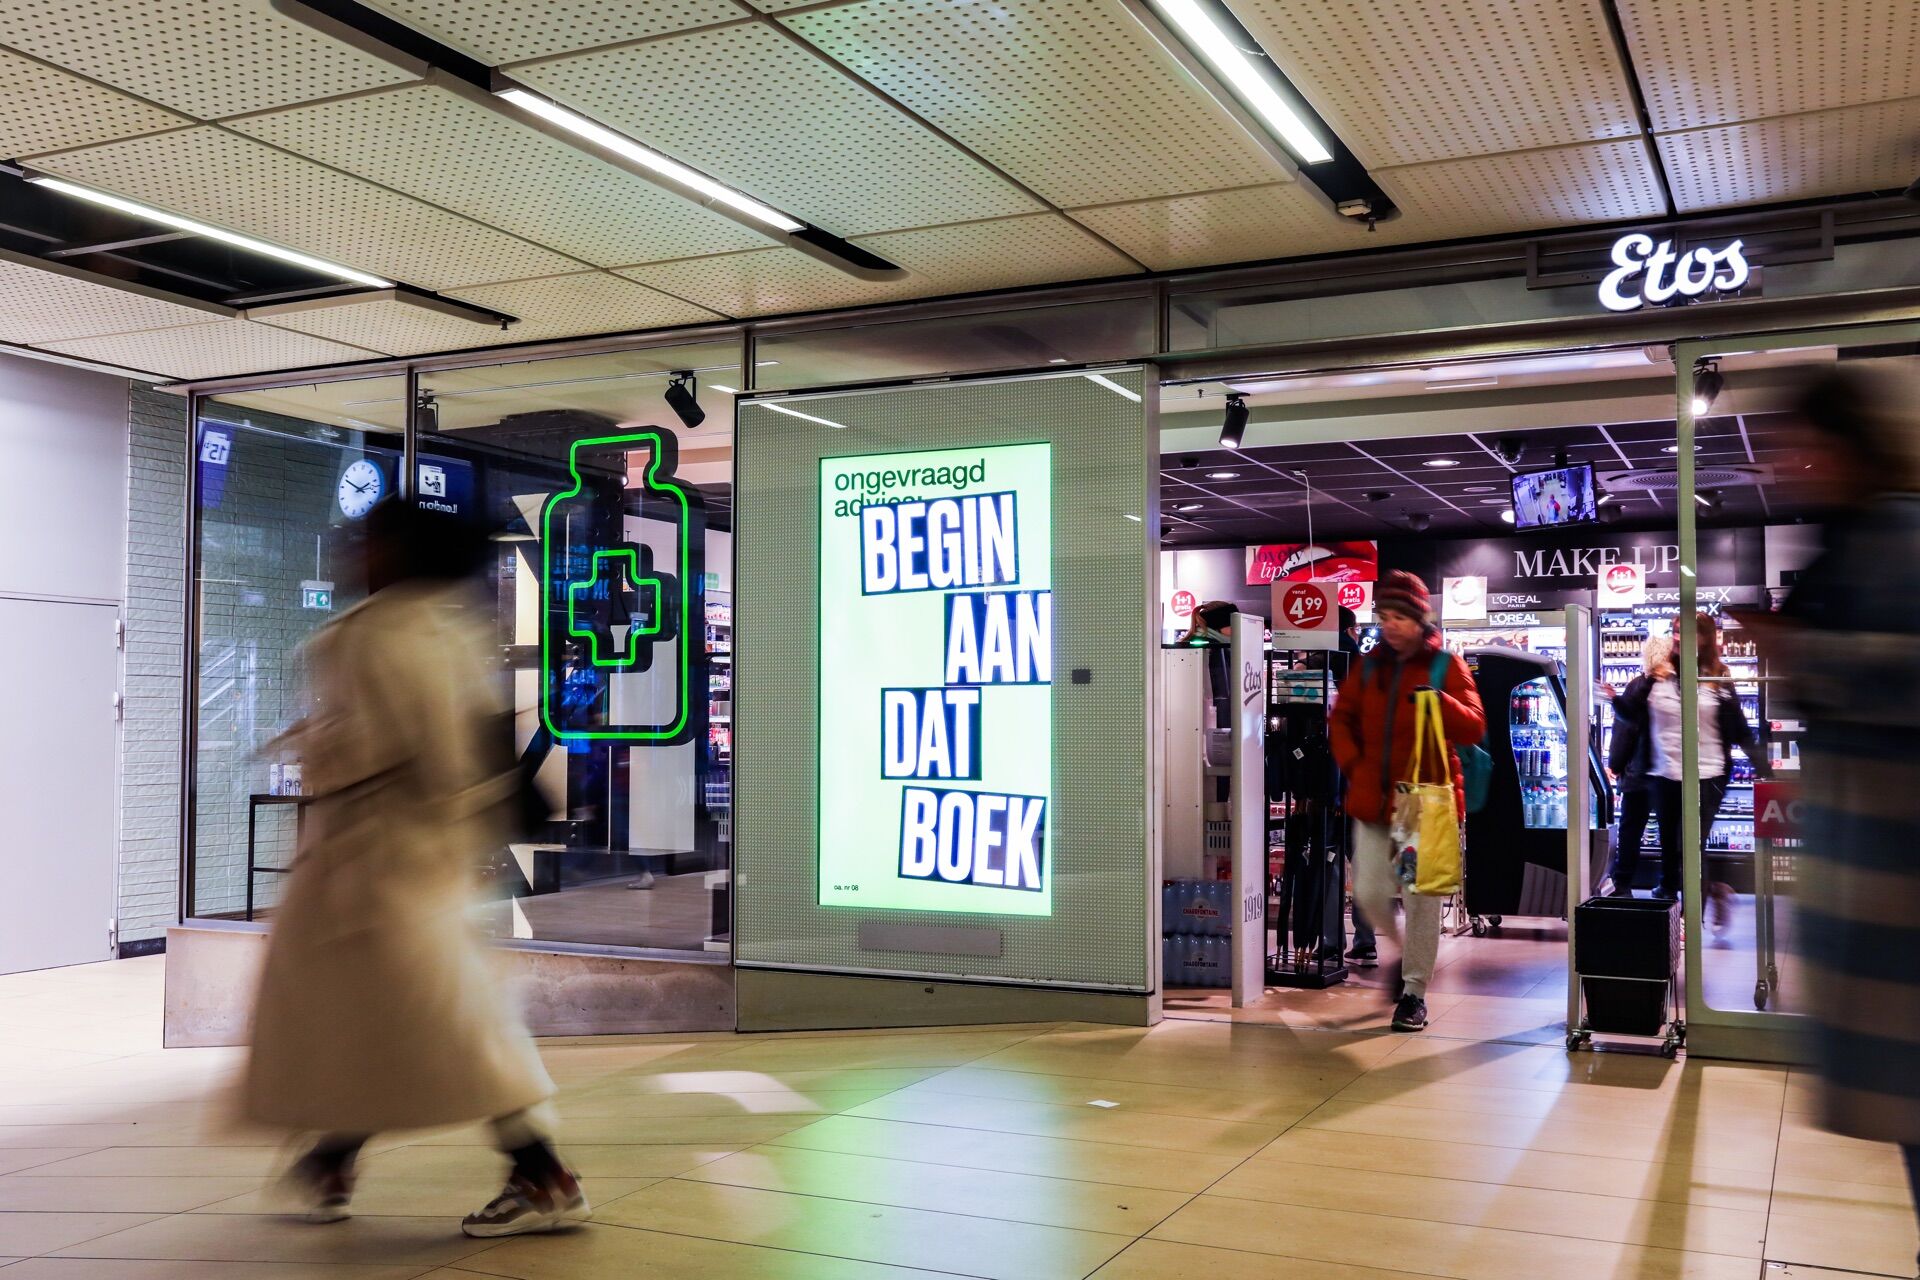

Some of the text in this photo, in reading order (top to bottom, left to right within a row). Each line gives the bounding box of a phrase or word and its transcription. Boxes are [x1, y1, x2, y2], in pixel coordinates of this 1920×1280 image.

[1598, 233, 1749, 311] Etos
[834, 458, 985, 495] ongevraagd
[863, 494, 1016, 593] BEGIN
[1252, 546, 1305, 565] lovely
[1260, 561, 1290, 582] lips
[1342, 597, 1361, 605] gratis
[1343, 587, 1361, 598] 1+1
[1656, 591, 1716, 601] FACOR
[1660, 606, 1708, 614] FACR
[945, 593, 1052, 683] AAN
[1243, 661, 1262, 693] Etos
[884, 689, 980, 777] DAT
[1761, 799, 1807, 824] AC
[901, 788, 1045, 889] BOEK
[1244, 892, 1263, 923] 1919
